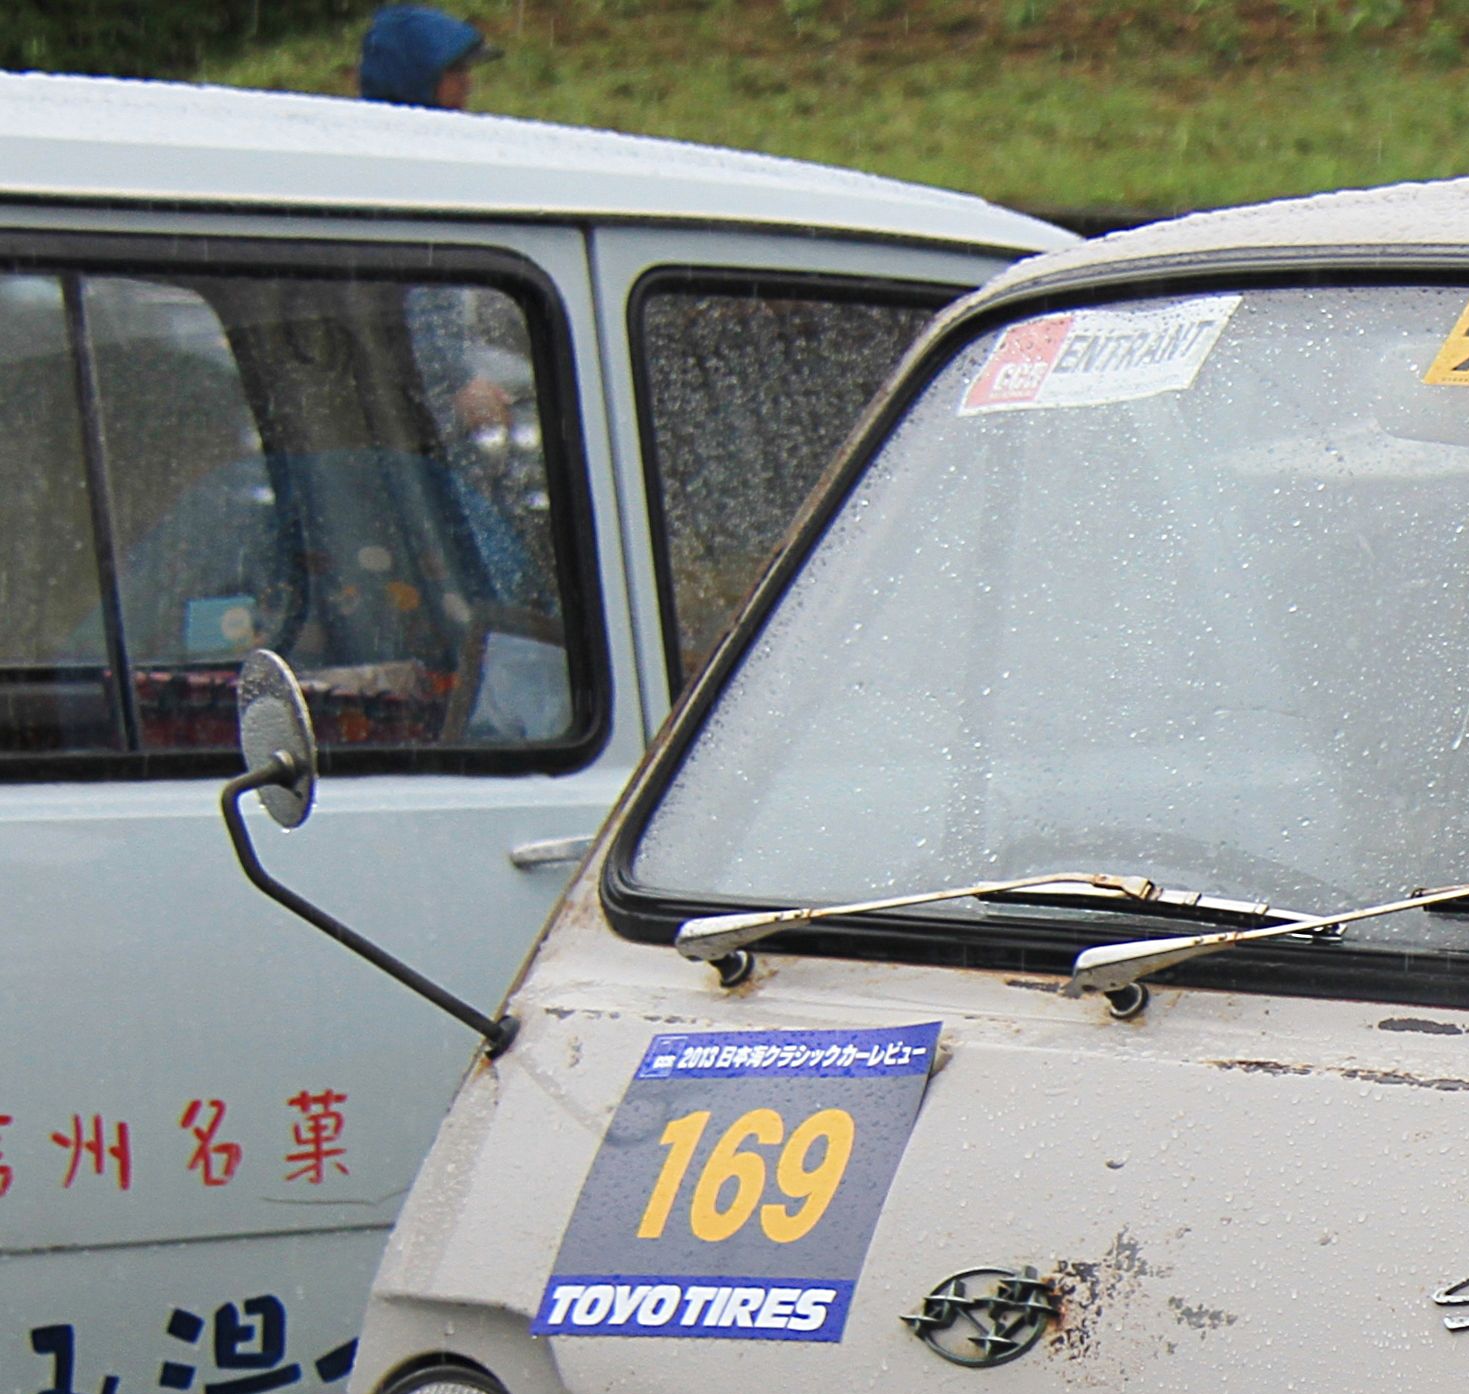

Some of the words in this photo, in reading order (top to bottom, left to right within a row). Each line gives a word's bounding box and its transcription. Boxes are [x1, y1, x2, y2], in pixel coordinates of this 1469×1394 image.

[1052, 318, 1216, 374] ENTRANT
[677, 1045, 719, 1070] 2013
[715, 1041, 926, 1069] 日本海クラシックカーレビュー
[636, 1108, 855, 1244] 169
[548, 1284, 682, 1327] TOYO
[680, 1286, 837, 1332] TIRES
